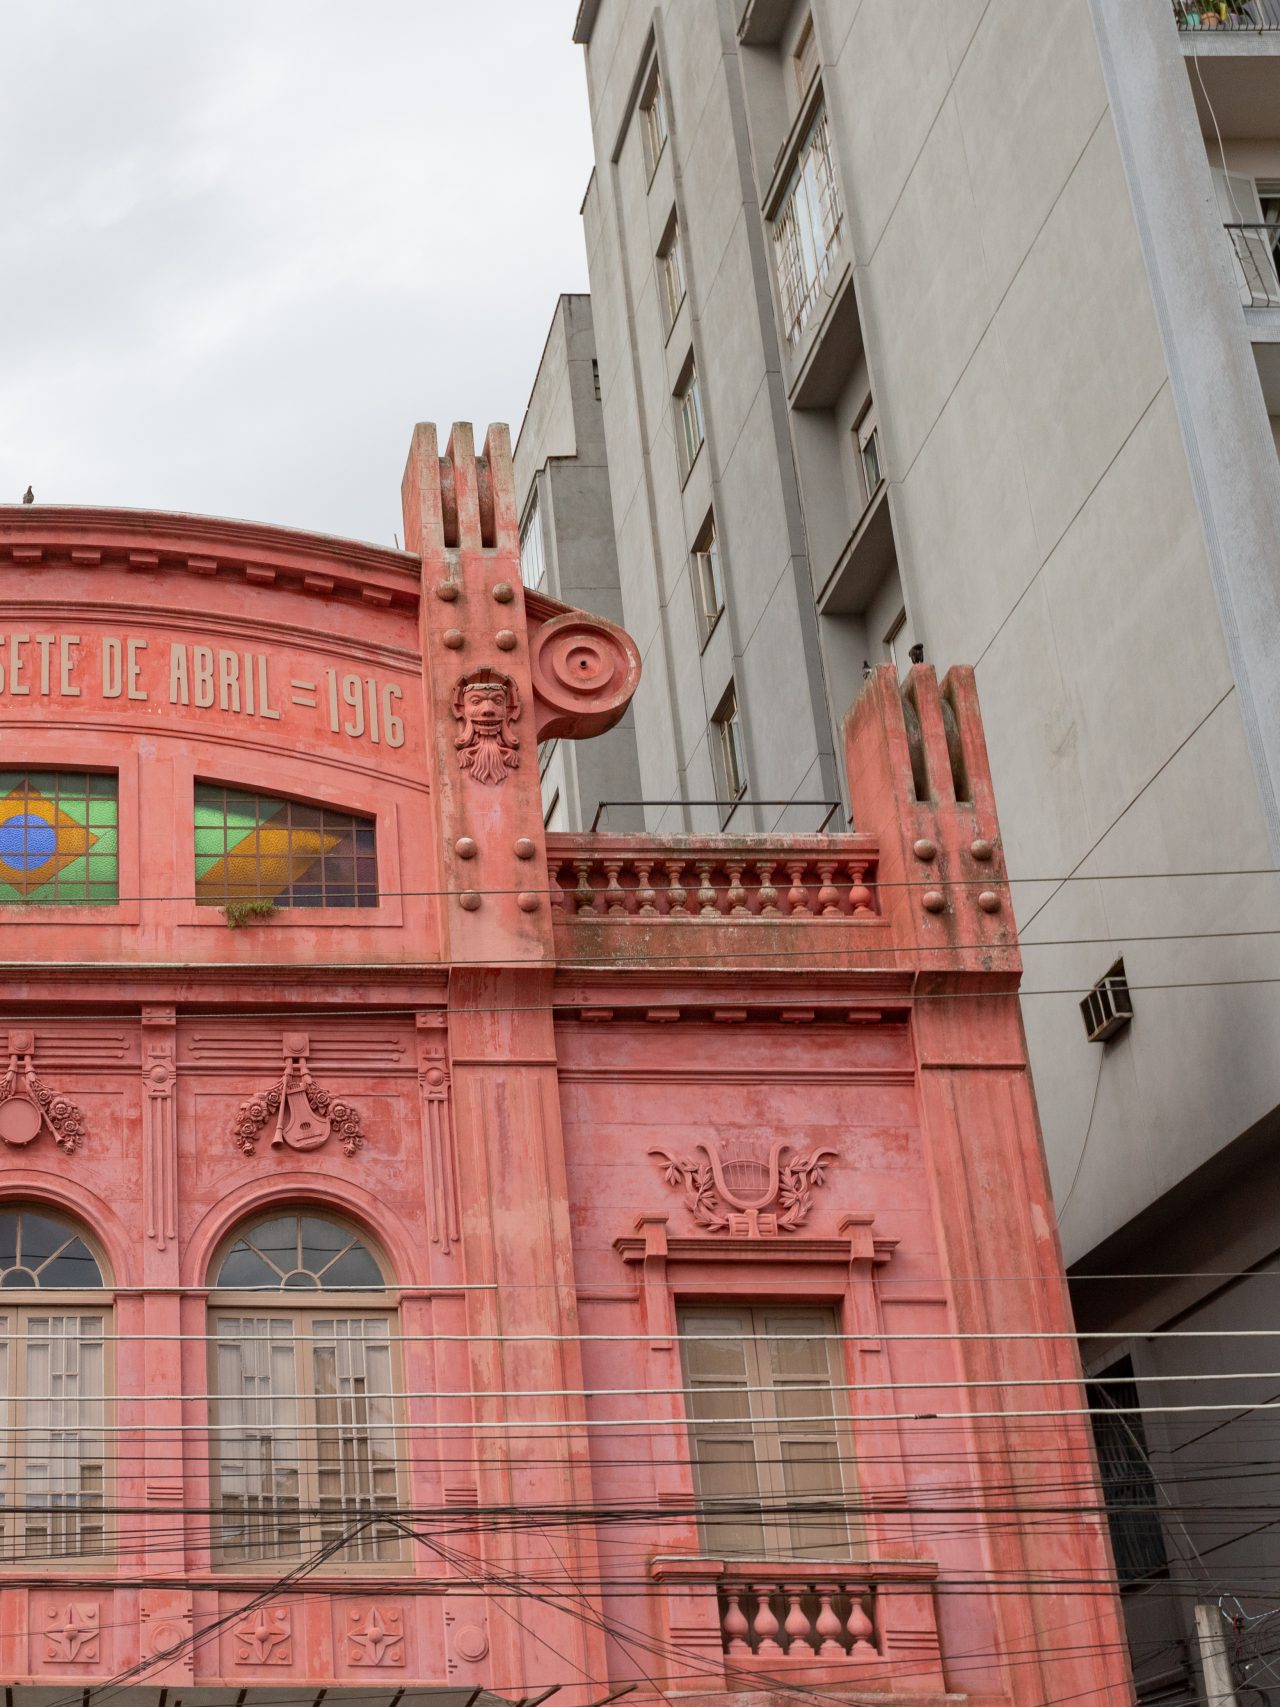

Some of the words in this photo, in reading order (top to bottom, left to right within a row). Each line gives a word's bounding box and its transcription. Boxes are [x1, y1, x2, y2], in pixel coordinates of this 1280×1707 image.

[102, 637, 148, 701] DE
[169, 642, 281, 720] ABRIL
[326, 668, 406, 748] 1916
